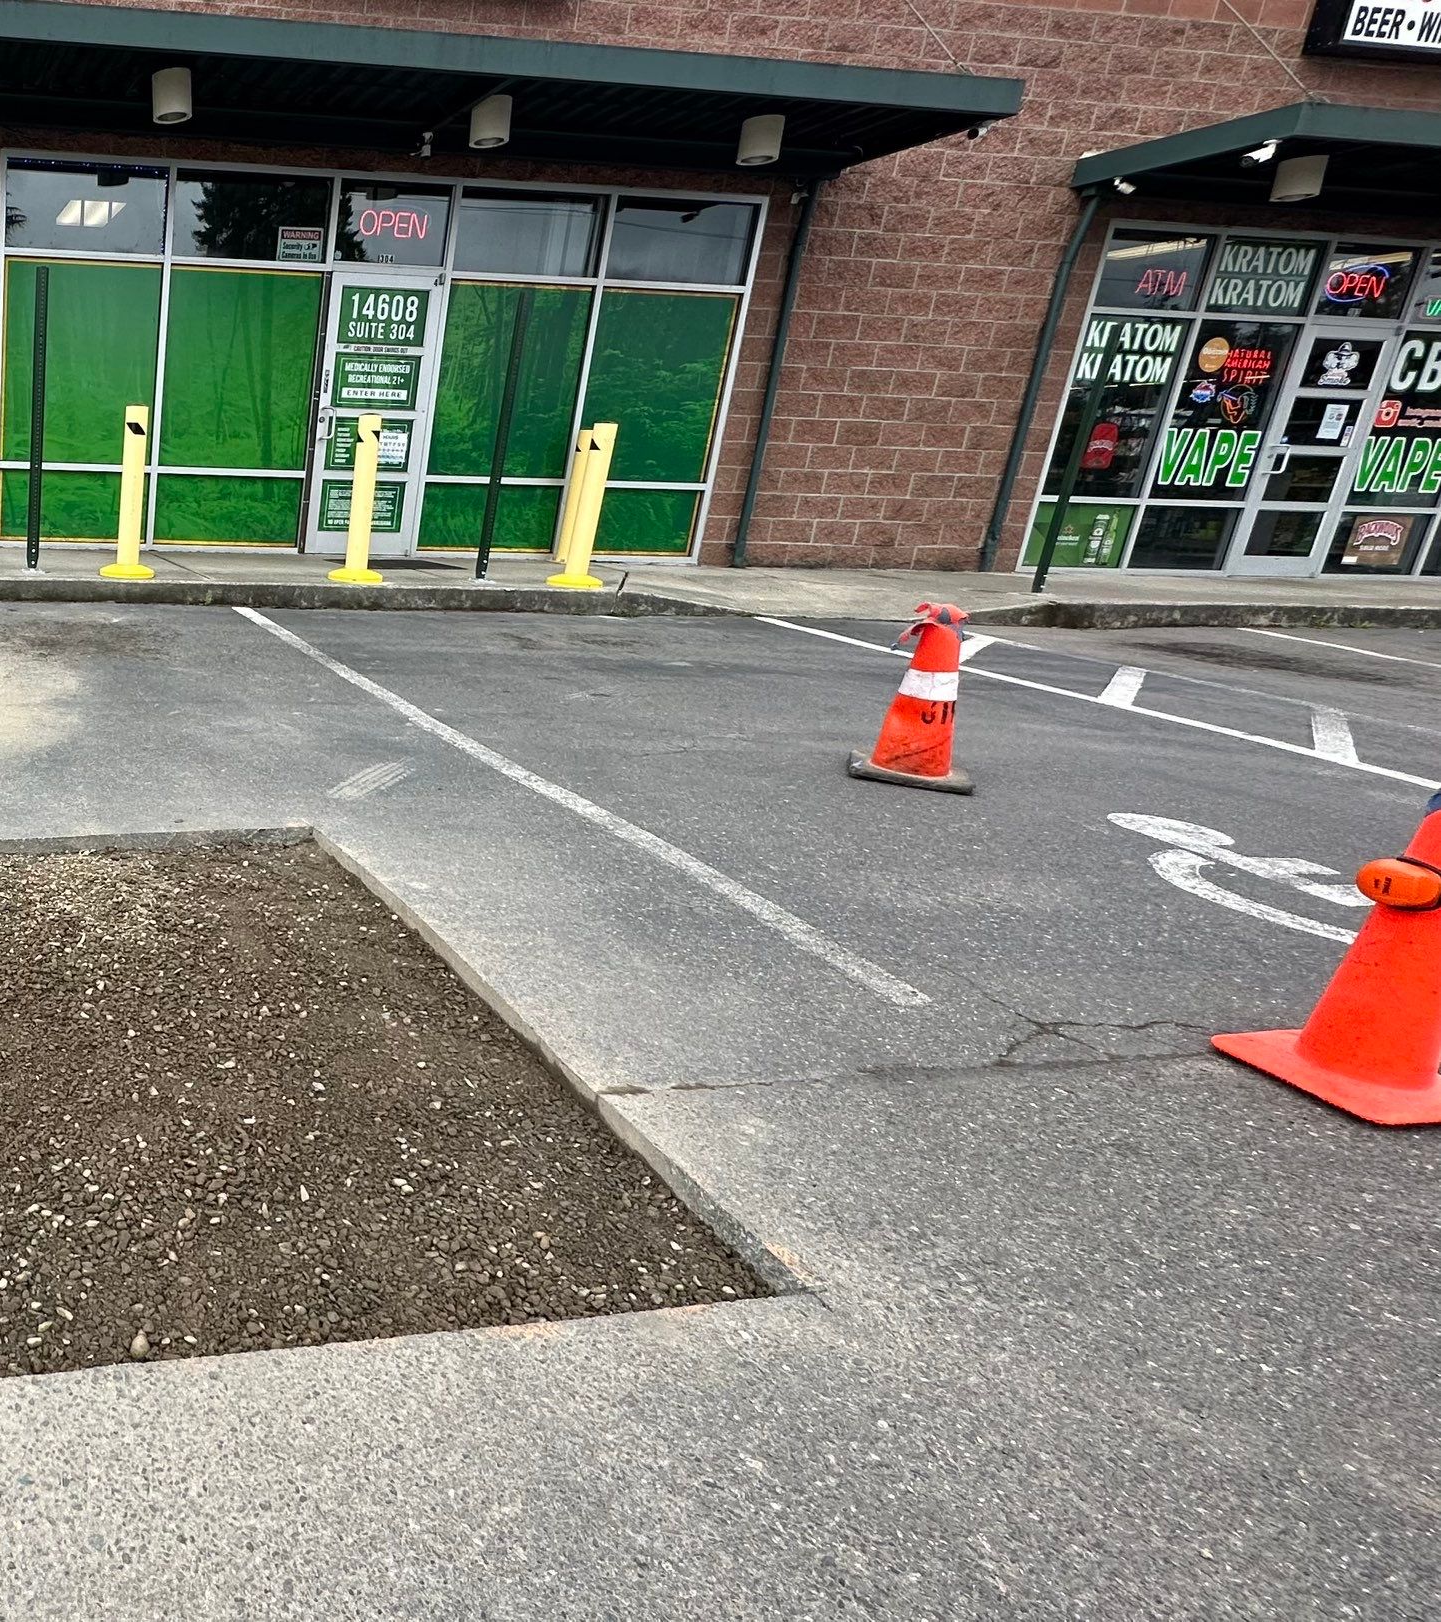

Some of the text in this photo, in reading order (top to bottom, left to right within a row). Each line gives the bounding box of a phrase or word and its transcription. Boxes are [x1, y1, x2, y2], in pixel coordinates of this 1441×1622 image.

[1351, 6, 1406, 39] BEER
[283, 231, 319, 240] WARNING
[360, 210, 428, 239] OPEN
[1219, 244, 1316, 276] KRATOM
[1135, 269, 1187, 297] ATM
[1209, 278, 1306, 308] KRATOM
[1327, 272, 1386, 298] OPEN
[352, 292, 419, 323] 14608
[347, 321, 415, 340] SUITE 304
[345, 362, 411, 374] MEDICALLY ENDORSED
[1076, 353, 1173, 383] KATOM
[1222, 368, 1268, 384] SPIRIT
[1224, 358, 1271, 370] AMERICAN
[346, 389, 376, 397] ENTER
[347, 374, 405, 385] RECREATIONAL 21+
[1158, 428, 1262, 487] VAPE
[1354, 436, 1441, 493] VAPE
